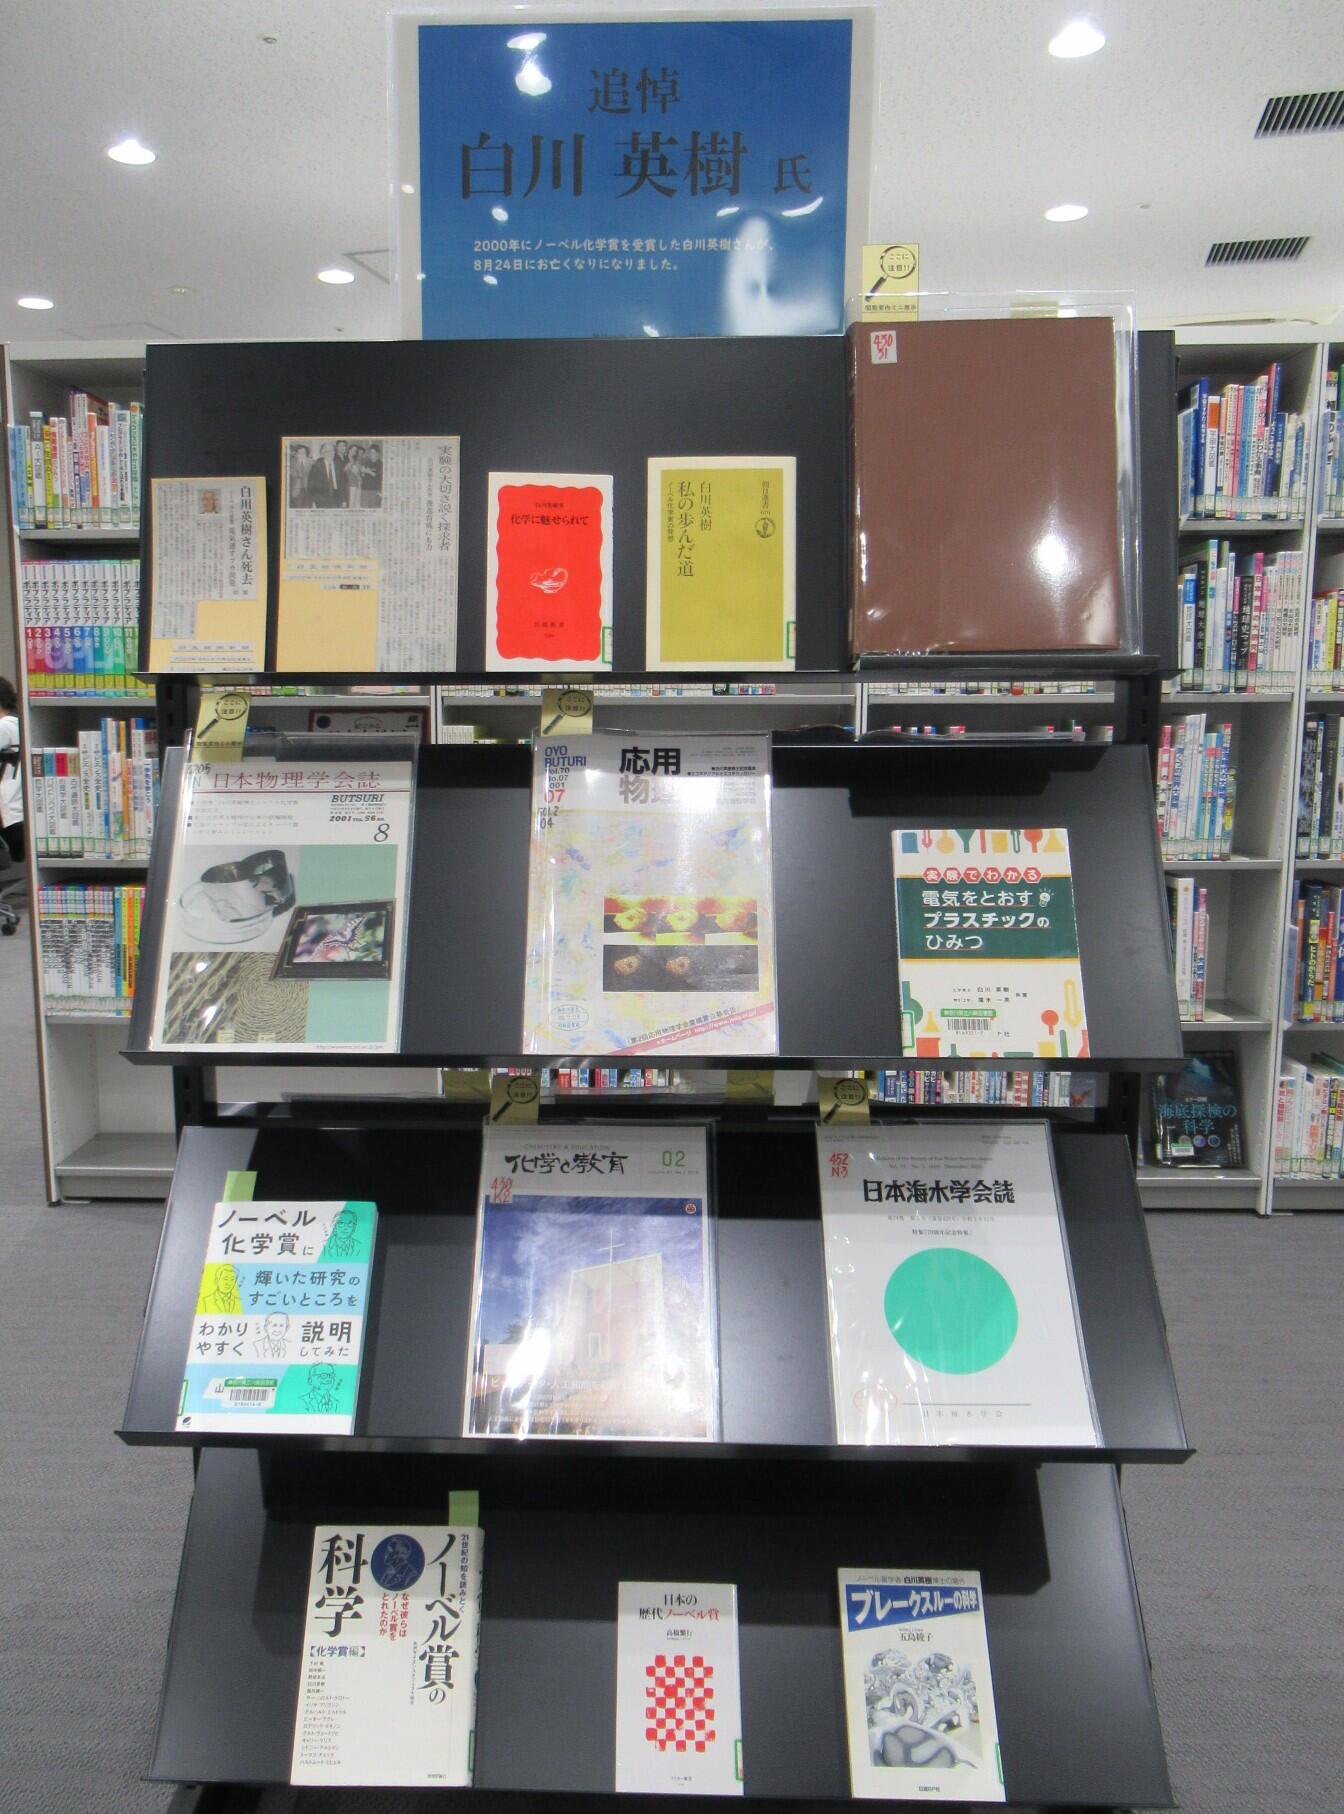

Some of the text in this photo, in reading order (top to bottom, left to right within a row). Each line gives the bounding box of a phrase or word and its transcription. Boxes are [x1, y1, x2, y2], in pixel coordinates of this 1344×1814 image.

[588, 67, 681, 115] 追悼
[460, 131, 813, 199] 白川 英樹 氏
[474, 258, 680, 272] 8月24日にお亡くなりになりました。
[700, 481, 712, 532] 白川英樹
[510, 514, 590, 526] 化学に魅せられて
[240, 485, 252, 586] 白川英樹さん死去
[678, 481, 695, 577] 私の歩んだ道
[26, 628, 32, 637] 1
[34, 628, 42, 637] 2
[44, 628, 51, 637] 3
[74, 628, 81, 637] 6
[545, 745, 568, 757] OYO
[544, 756, 587, 768] BUTURI
[619, 747, 681, 776] 応用
[213, 770, 381, 790] 日本物理学会誌
[331, 793, 385, 803] BUTSURI
[544, 789, 565, 804] 07
[373, 823, 390, 842] 8
[926, 869, 1038, 882] 実験でわかる
[922, 890, 1033, 907] 電気をとおす
[923, 911, 1050, 928] プラスチックの
[925, 935, 984, 950] ひみつ
[1158, 1103, 1238, 1118] 海底探検の
[1183, 1119, 1215, 1135] 科学
[505, 1152, 628, 1175] 化学と教育
[662, 1150, 687, 1168] 02
[829, 1153, 849, 1166] 452
[863, 1178, 1016, 1204] 日本海水学会誌
[218, 1209, 317, 1228] ノーベル
[221, 1232, 314, 1255] 化学賞に
[254, 1268, 361, 1287] 輝いた研究の
[249, 1291, 358, 1307] すごいところを
[199, 1321, 248, 1336] わかり
[301, 1321, 352, 1344] 説明
[196, 1340, 246, 1357] やすく
[299, 1346, 350, 1358] してみた
[459, 1534, 470, 1614] 21世紀の知を読みとく
[314, 1533, 369, 1639] 科学
[664, 1593, 698, 1607] 日本の
[851, 1589, 978, 1625] ブレークスルーの科学
[379, 1592, 390, 1637] とれたのか
[389, 1592, 400, 1641] ノーベル賞を
[398, 1592, 410, 1638] なぜ彼らは
[415, 1533, 463, 1705] ノーベル賞の
[639, 1607, 720, 1621] 歴代ノーベル賞
[309, 1645, 366, 1658] 【化学賞編】
